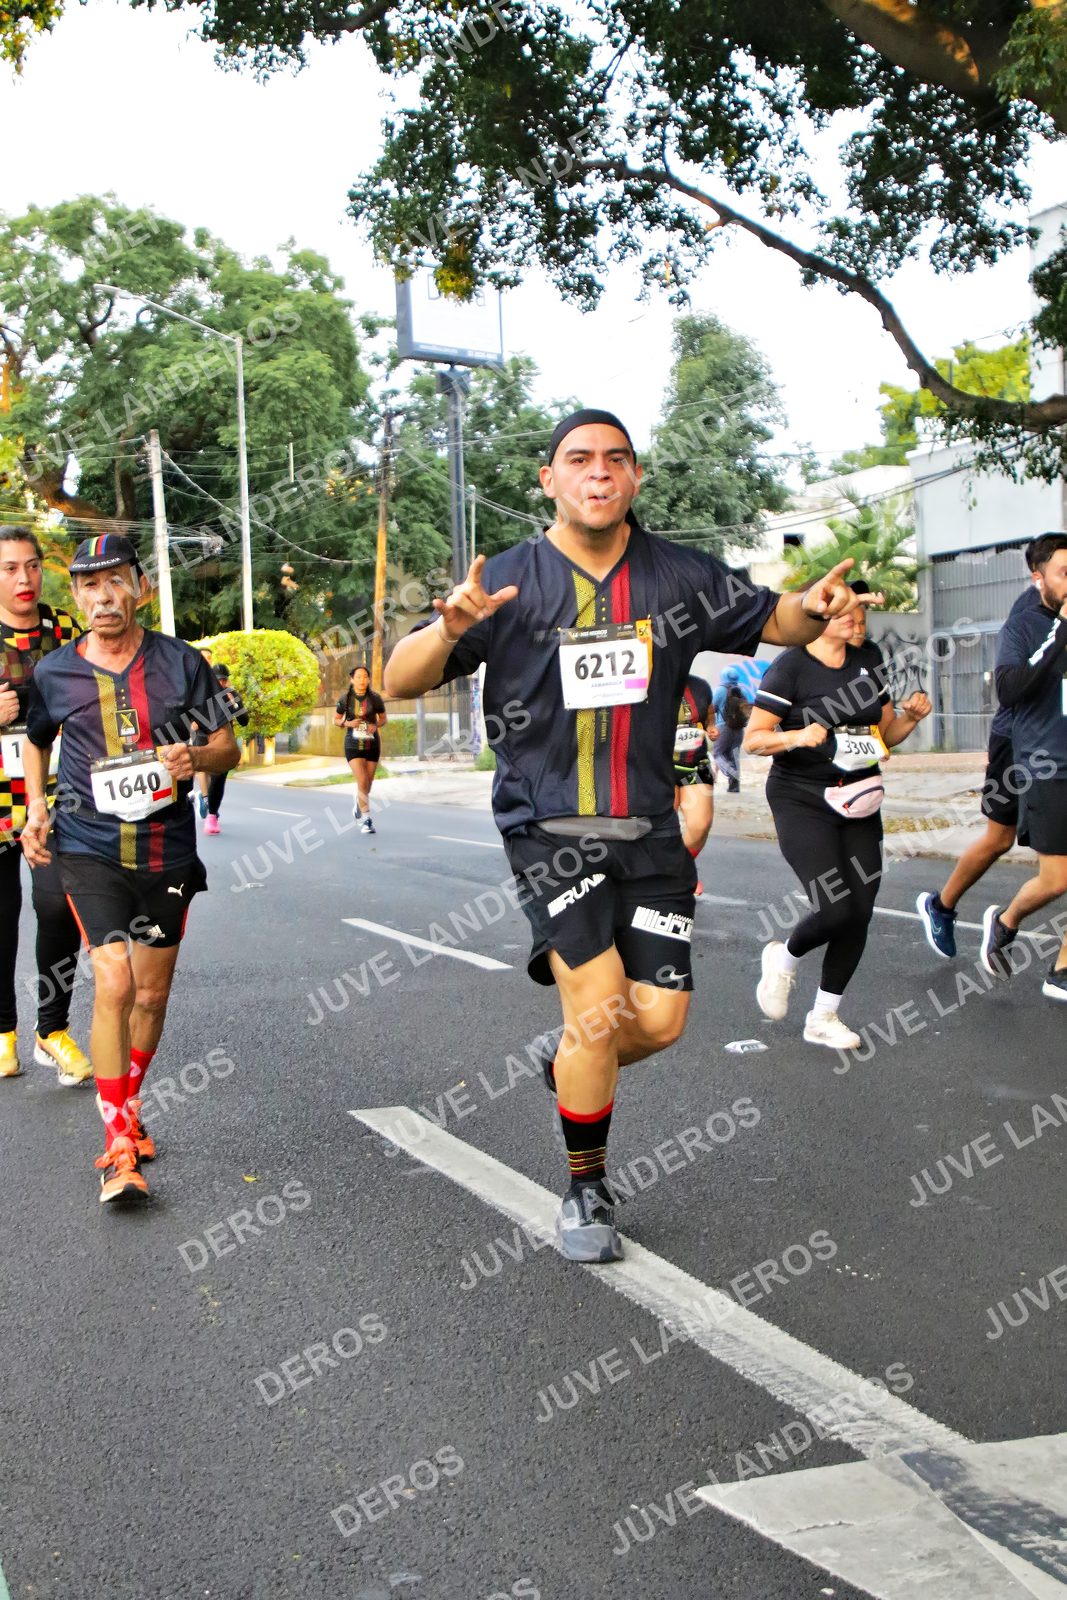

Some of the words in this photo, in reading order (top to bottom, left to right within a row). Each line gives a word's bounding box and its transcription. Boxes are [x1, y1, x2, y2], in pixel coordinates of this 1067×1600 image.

[574, 649, 636, 681] 6212
[678, 729, 700, 742] 4356
[844, 739, 876, 755] 3300
[103, 771, 161, 801] 1640
